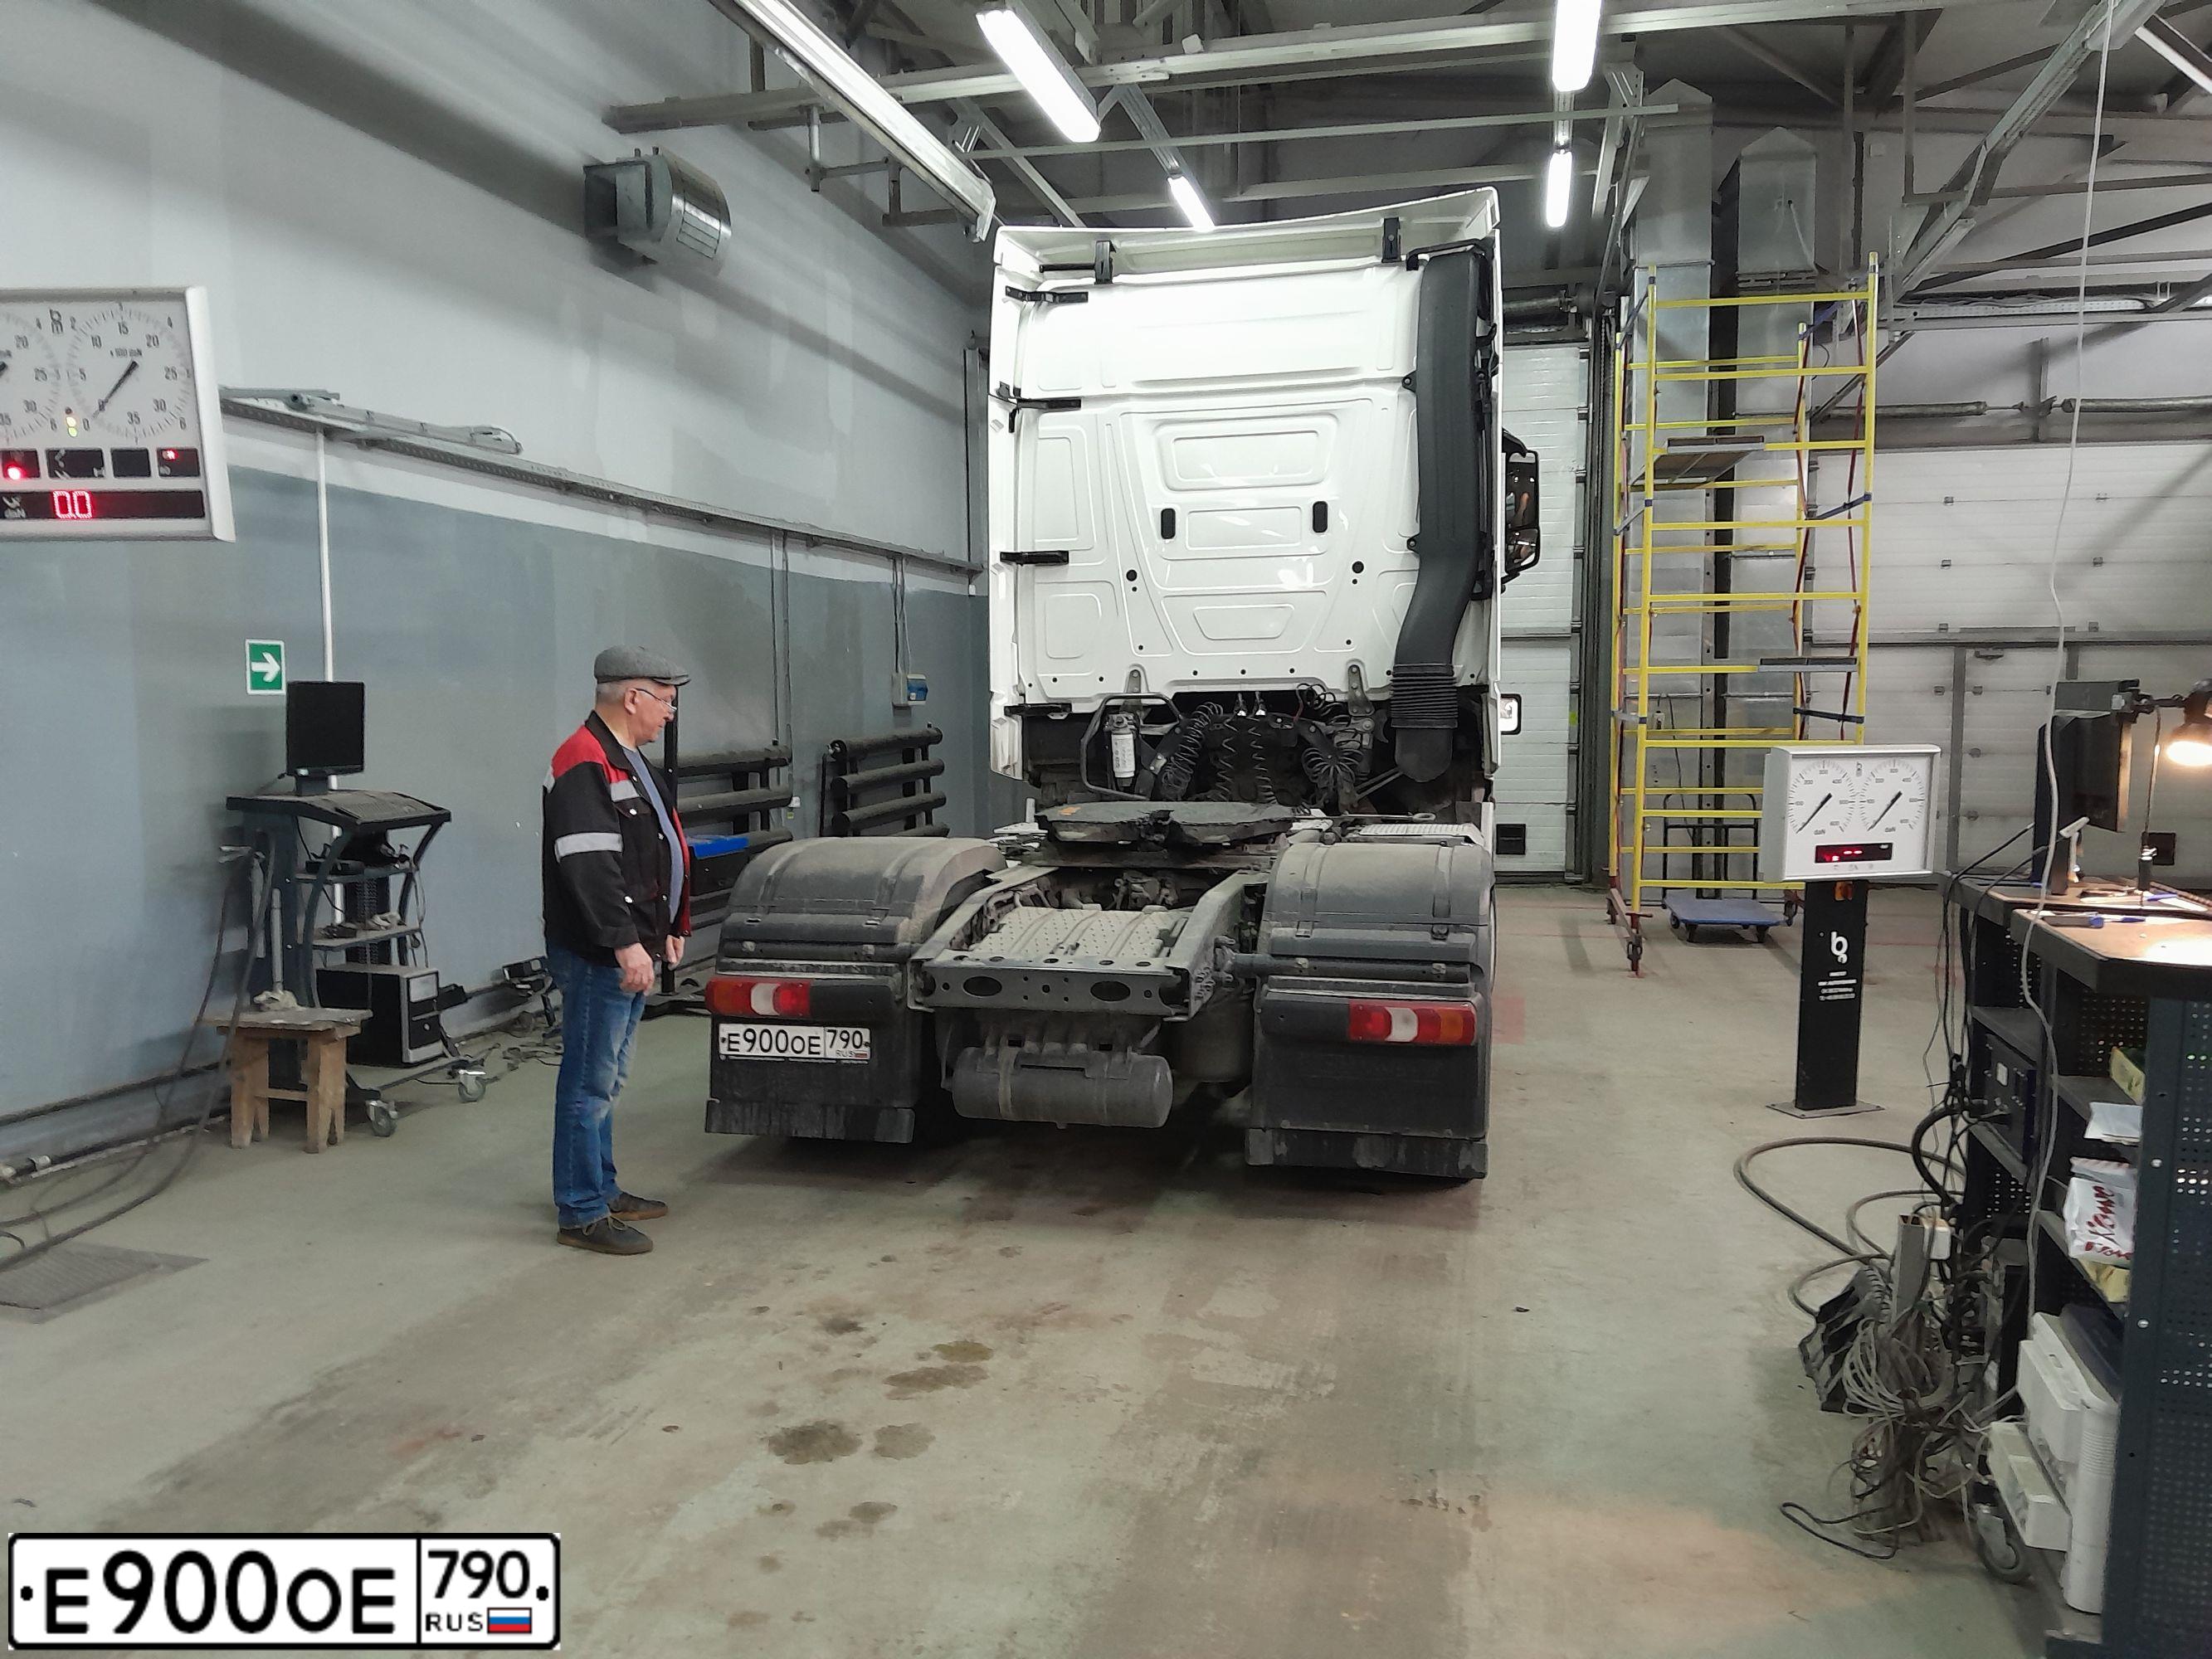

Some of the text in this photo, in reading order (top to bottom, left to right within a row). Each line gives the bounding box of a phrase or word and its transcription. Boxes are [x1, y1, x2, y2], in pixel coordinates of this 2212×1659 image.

[153, 398, 167, 412] 30
[127, 411, 141, 425] 35
[727, 1028, 863, 1055] E900OE 790
